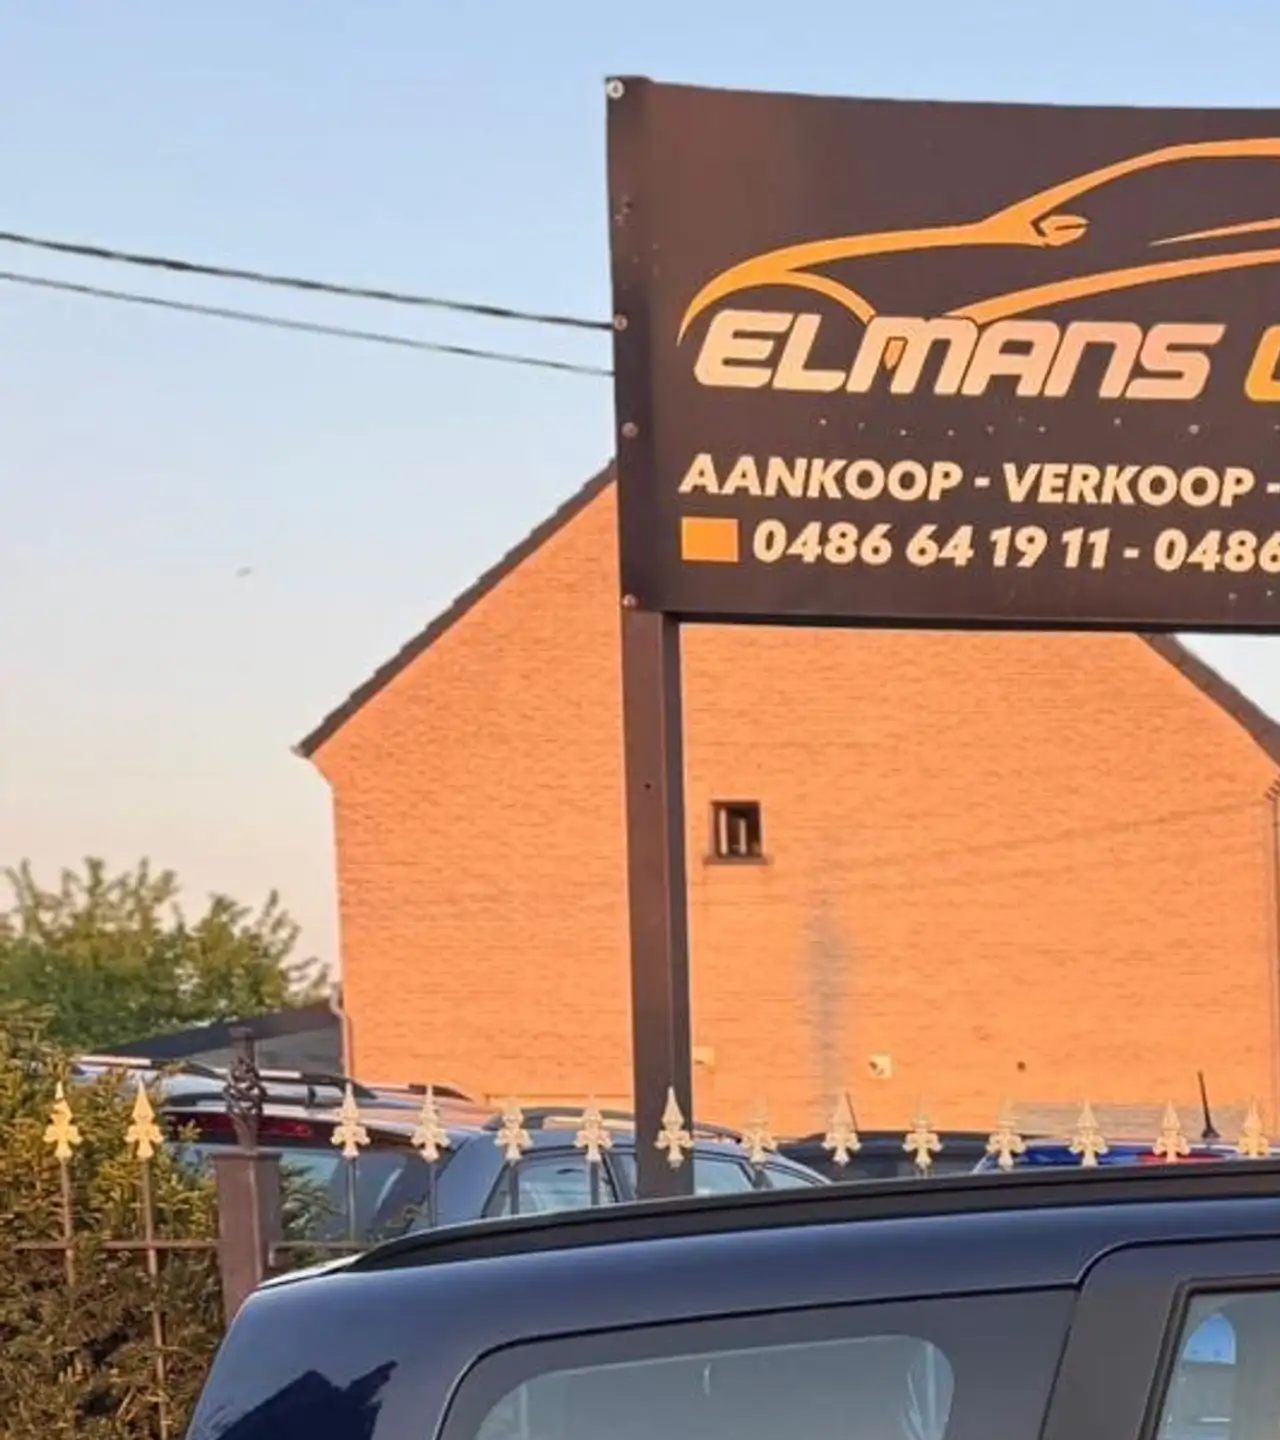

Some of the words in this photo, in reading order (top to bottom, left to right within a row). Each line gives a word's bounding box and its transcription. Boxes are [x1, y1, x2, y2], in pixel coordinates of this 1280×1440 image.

[693, 307, 1226, 400] ELMANS
[678, 452, 964, 501] AANKOOP
[1002, 462, 1255, 508] VERKOOP
[752, 519, 893, 565] 0486
[905, 524, 975, 567] 64
[989, 525, 1048, 568] 19
[1061, 527, 1110, 569] 11
